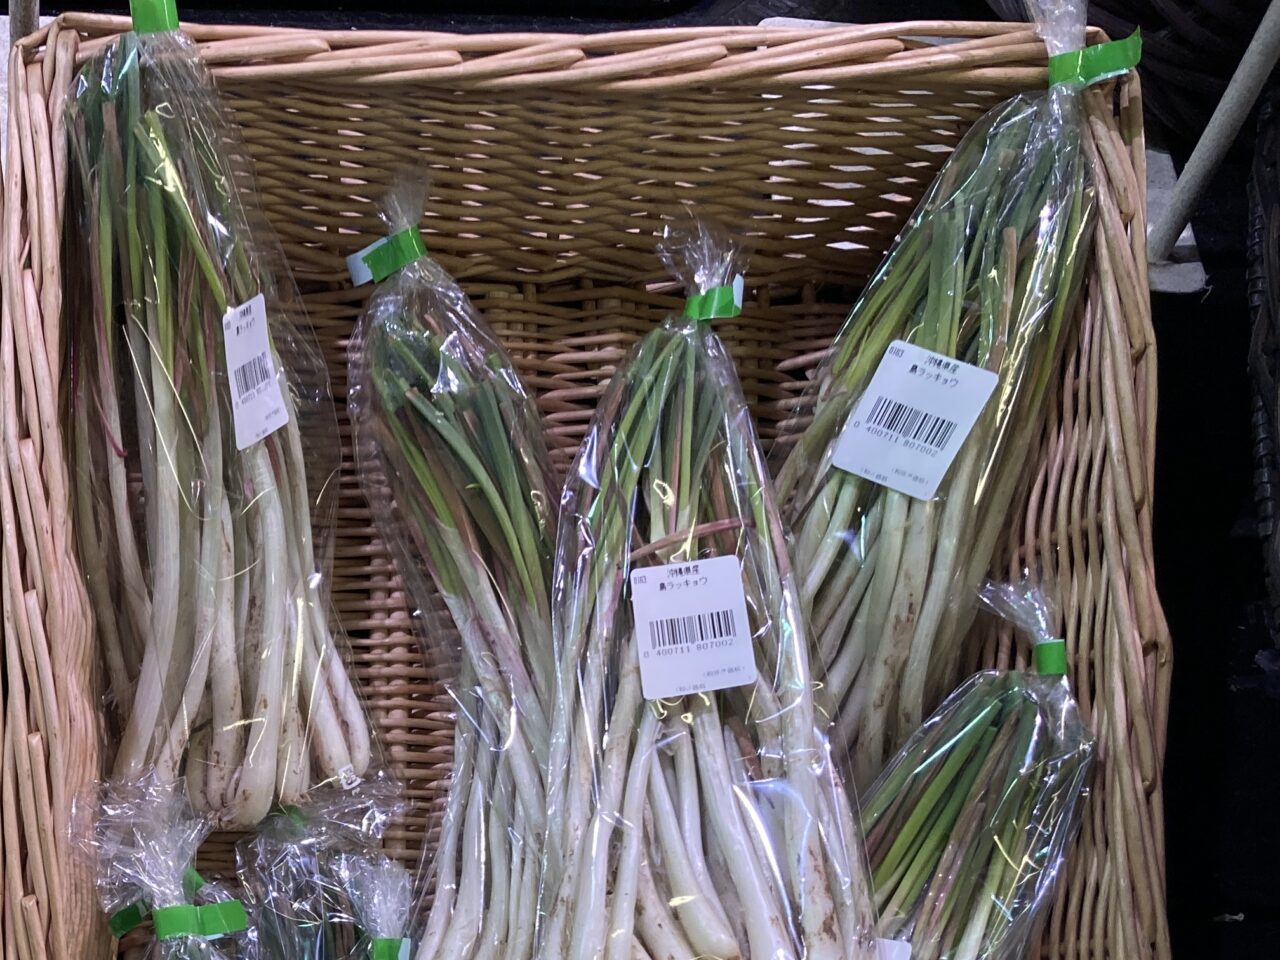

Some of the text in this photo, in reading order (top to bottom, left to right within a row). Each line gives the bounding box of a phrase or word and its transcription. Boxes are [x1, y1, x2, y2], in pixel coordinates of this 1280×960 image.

[908, 365, 959, 388] 島ラッキョウ
[866, 426, 898, 444] 400711
[903, 440, 938, 457] 807002
[667, 565, 699, 578] 沖縄県産
[659, 577, 708, 591] 島ラッキョウ
[656, 646, 690, 656] 400711
[696, 640, 733, 650] 807002
